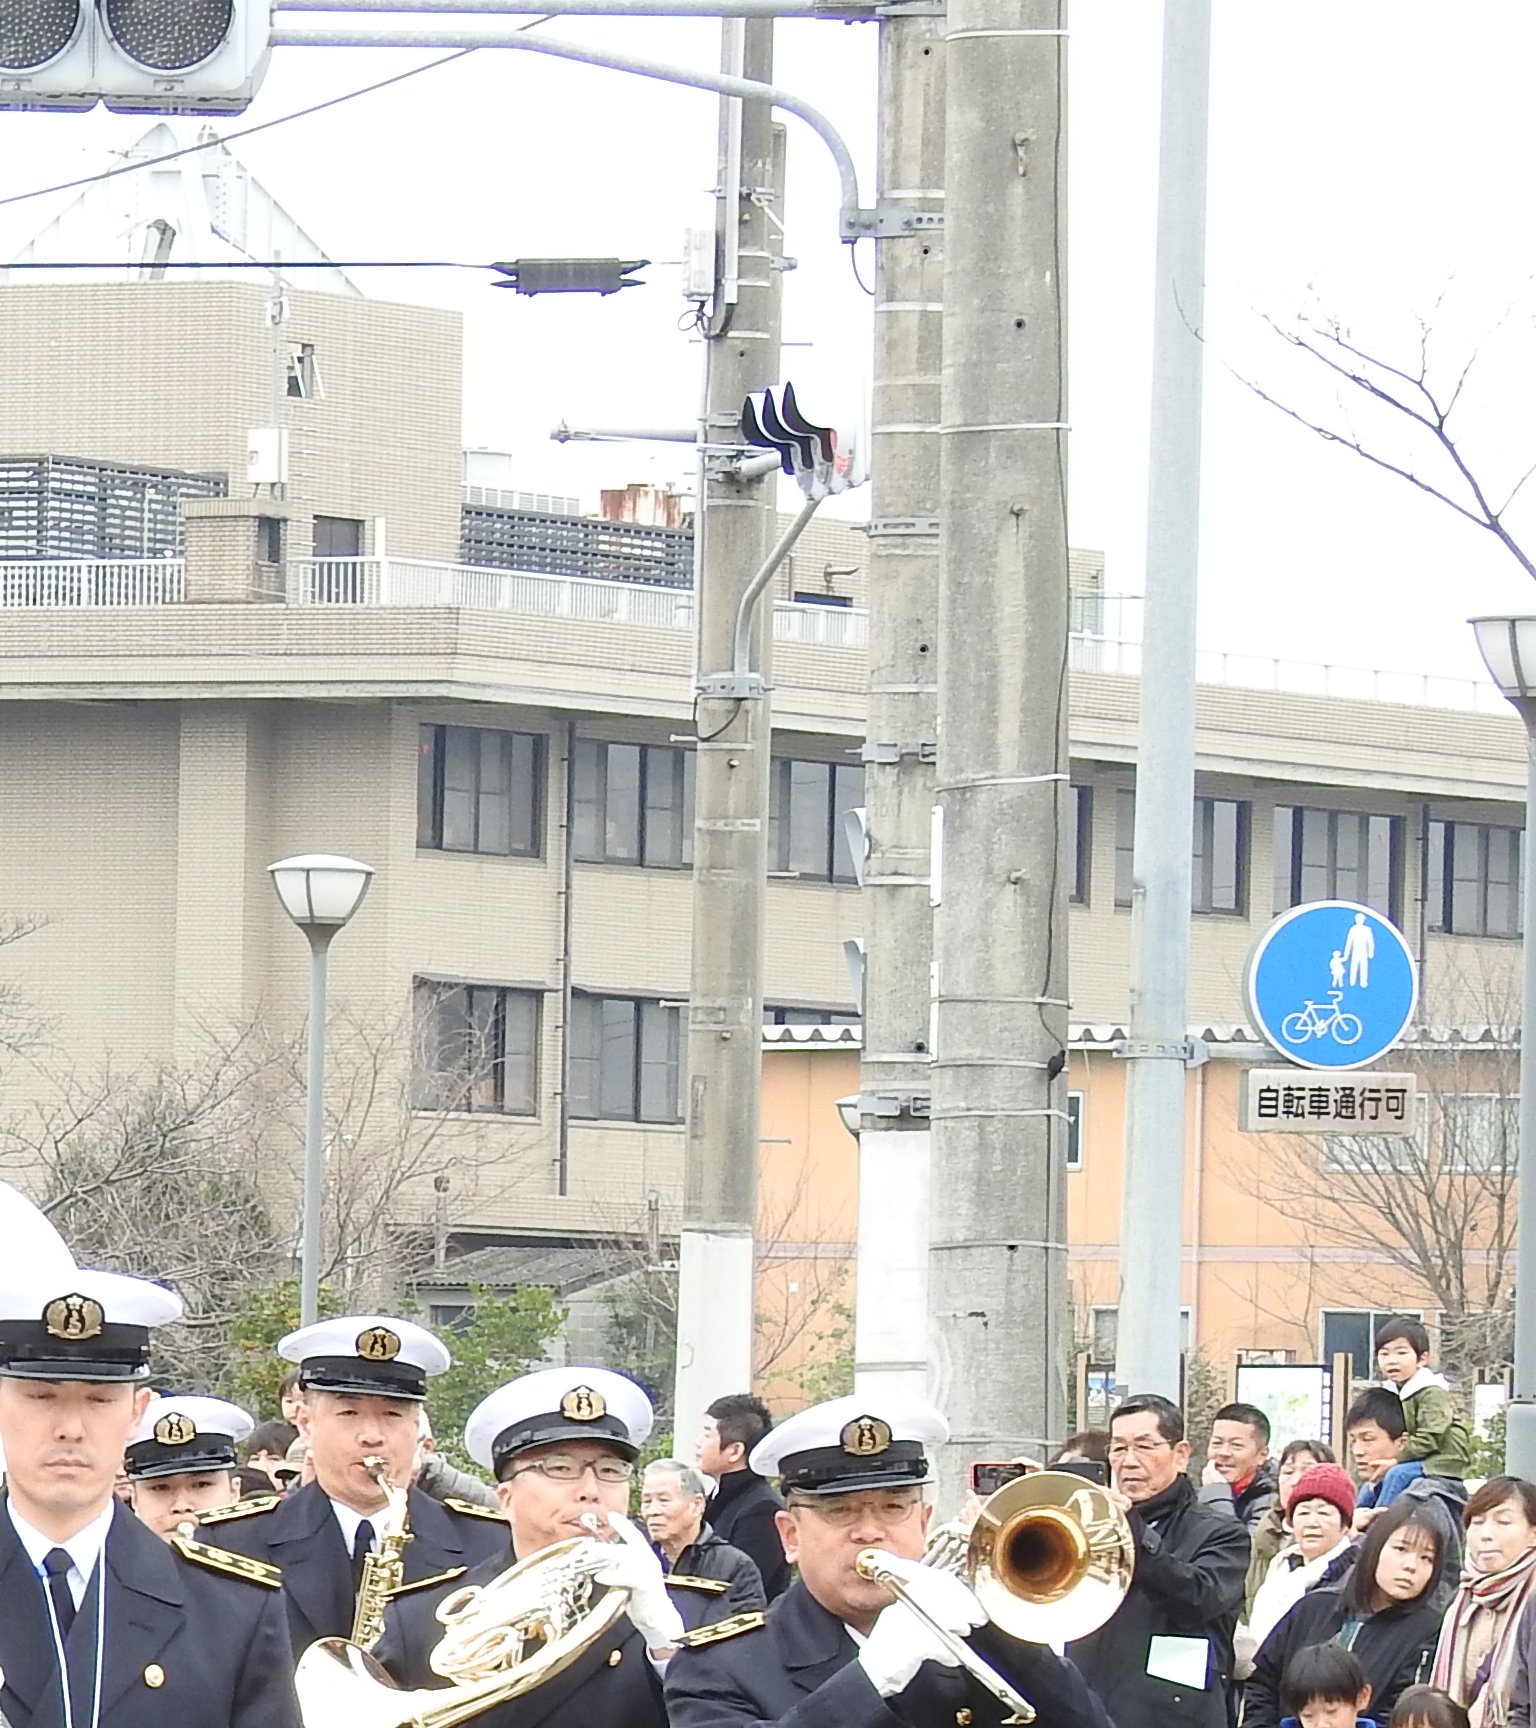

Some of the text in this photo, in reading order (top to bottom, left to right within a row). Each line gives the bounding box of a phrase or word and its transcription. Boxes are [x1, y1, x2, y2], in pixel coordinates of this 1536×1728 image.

[1258, 1085, 1407, 1120] 自転車通行可
